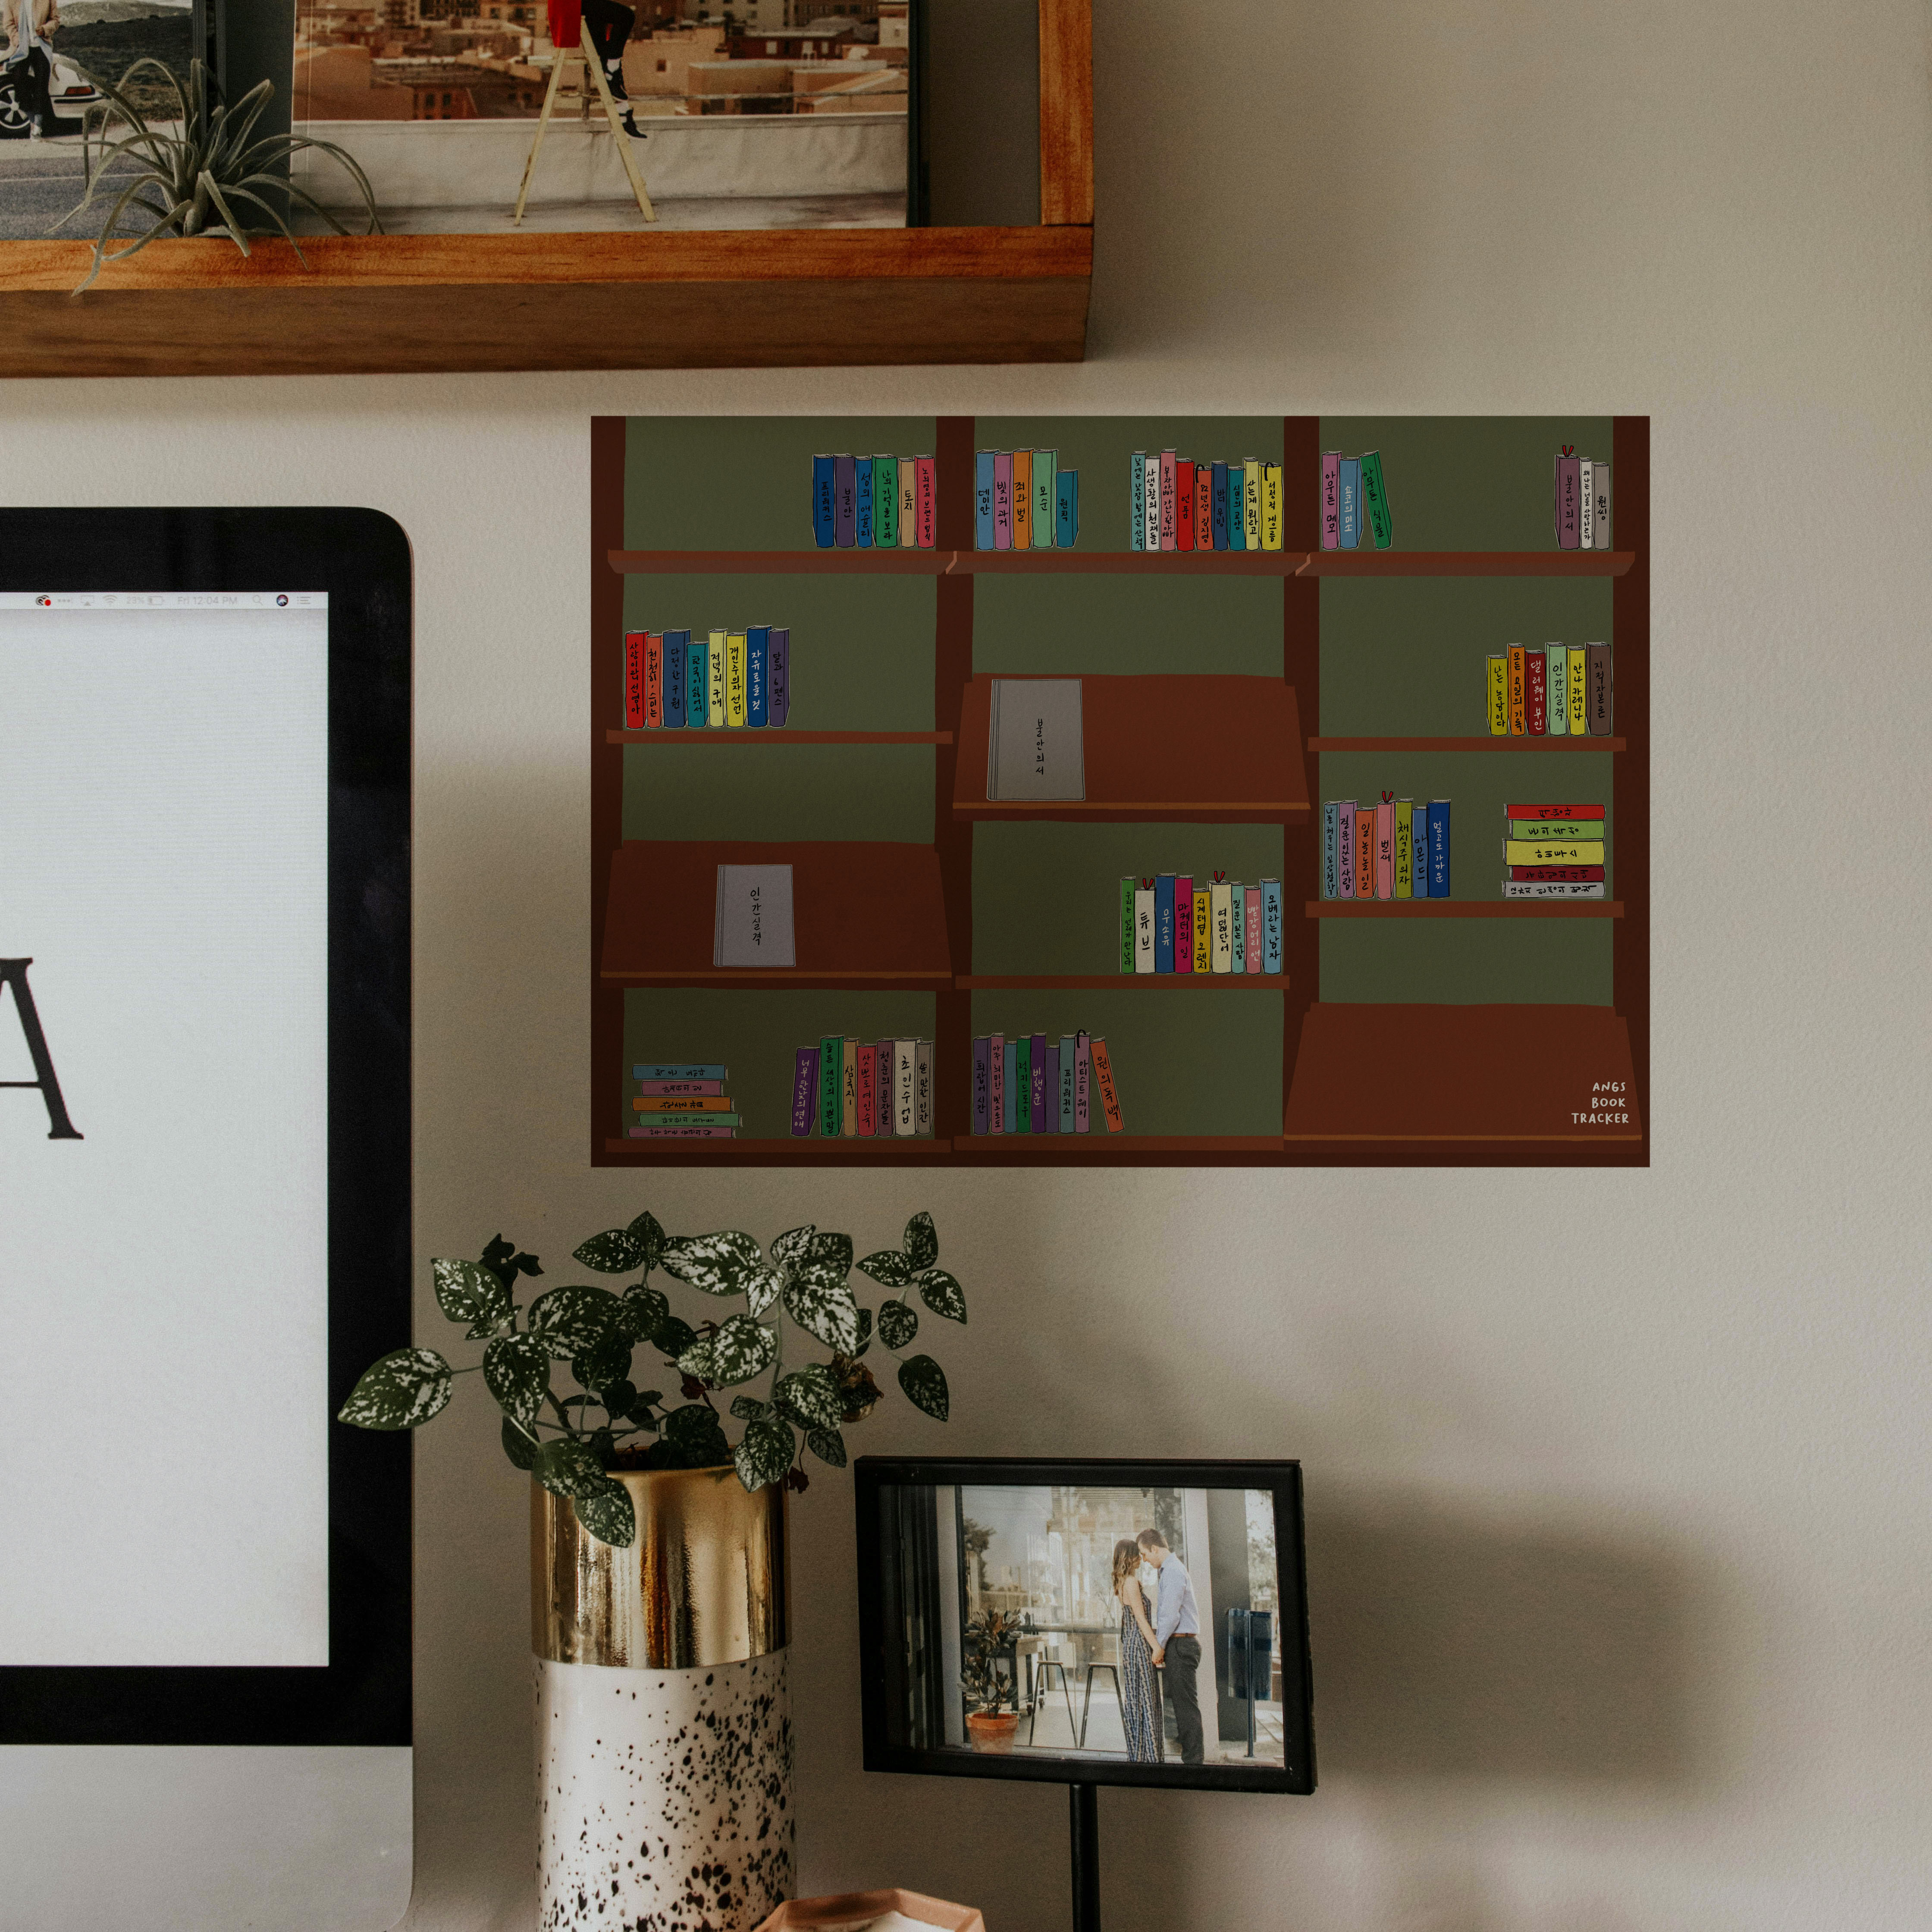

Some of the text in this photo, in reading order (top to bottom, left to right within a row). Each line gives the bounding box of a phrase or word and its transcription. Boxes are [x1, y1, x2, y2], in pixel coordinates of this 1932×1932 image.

[860, 473, 870, 497] 성의
[883, 470, 891, 485] 나의
[1147, 468, 1156, 508] 사생활의
[1364, 467, 1377, 501] 아무튼
[1584, 478, 1590, 489] 나는
[904, 490, 913, 510] 토지
[978, 489, 990, 515] 데미안
[997, 482, 1008, 527] 빛의 과거
[1014, 482, 1027, 522] 죄와 벌
[1040, 486, 1048, 511] 모순
[1217, 489, 1225, 502] 바디
[1325, 471, 1336, 533] 아무튼 메모
[884, 522, 893, 539] 보라
[1248, 509, 1258, 534] 뭐라고
[1268, 514, 1276, 542] 게으름
[1345, 515, 1352, 531] 미소
[1135, 530, 1142, 549] 산책
[692, 656, 700, 683] 한국이
[773, 652, 783, 671] 달과
[1494, 665, 1503, 683] 나는
[630, 642, 640, 714] 사랑이라니 선영아
[671, 648, 680, 709] 다정한 구원
[711, 652, 721, 707] 저녁의 구애
[730, 646, 742, 714] 개인주의자 선언
[752, 650, 762, 710] 자유로울 것
[649, 693, 657, 717] 스미는
[1513, 652, 1522, 732] 모든 요일의 기록
[1531, 660, 1543, 730] 댈러웨이 부인
[1572, 663, 1583, 721] 안나 카레니나
[1326, 808, 1334, 824] 나를
[1380, 840, 1390, 862] 벌새
[1398, 821, 1410, 884] 채식주의자
[1414, 834, 1427, 879] 아몬드
[1433, 821, 1445, 882] 멀고도 가까운
[1535, 849, 1577, 858] 아비투스
[1342, 869, 1352, 890] 사람
[1571, 870, 1588, 879] 시대
[1140, 912, 1150, 950] 튜브
[1162, 909, 1170, 946] 무소유
[1197, 898, 1206, 969] 시계태엽 오렌지
[1247, 905, 1261, 962] 빨강머리 앤
[1268, 895, 1281, 960] 오베라는 남자
[1181, 947, 1188, 958] 일
[1236, 942, 1244, 960] 사람
[993, 1045, 1000, 1060] 아주
[795, 1060, 809, 1128] 너무 한낮의 연애
[825, 1043, 834, 1133] 슬픈 세상의 기쁜 말
[880, 1051, 890, 1125] 청춘의 문장들
[920, 1078, 928, 1097] 만한
[1033, 1067, 1042, 1105] 비행운
[1077, 1060, 1088, 1118] 아티스트 웨이
[1097, 1057, 1119, 1120] 원의 독백
[1593, 1082, 1625, 1092] ANGS
[919, 1102, 928, 1123] 인간
[978, 1096, 985, 1113] 시간
[1592, 1098, 1625, 1108] BOOK
[1571, 1113, 1628, 1124] TRACKER
